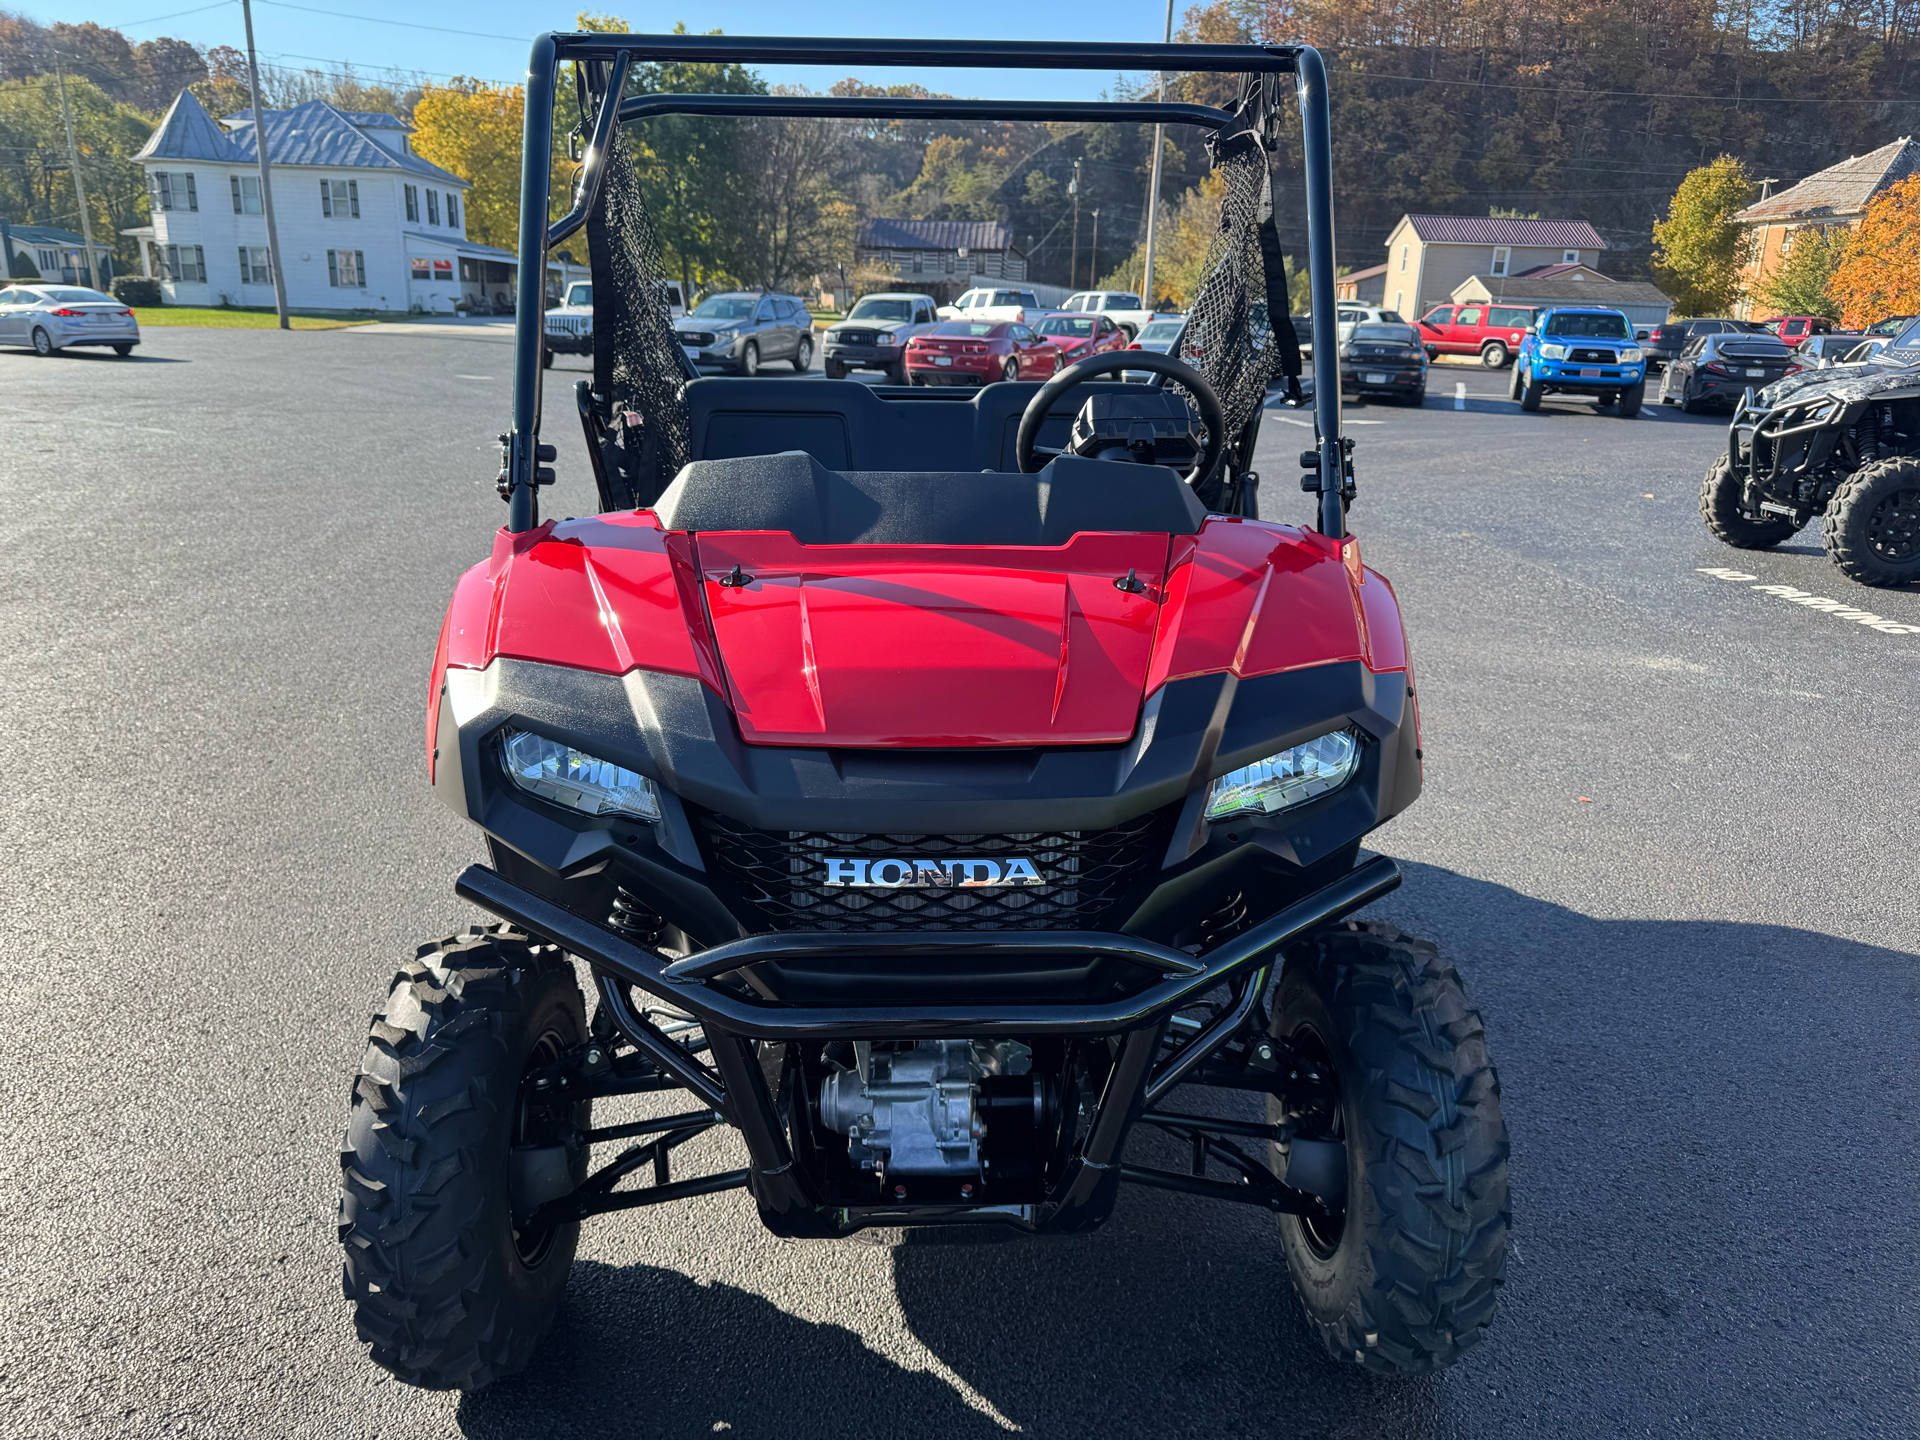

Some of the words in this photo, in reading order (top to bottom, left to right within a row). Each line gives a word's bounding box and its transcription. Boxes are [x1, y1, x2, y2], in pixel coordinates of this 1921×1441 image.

[1695, 567, 1757, 581] NO
[1750, 585, 1920, 634] PARKING
[824, 858, 1046, 887] HONDA
